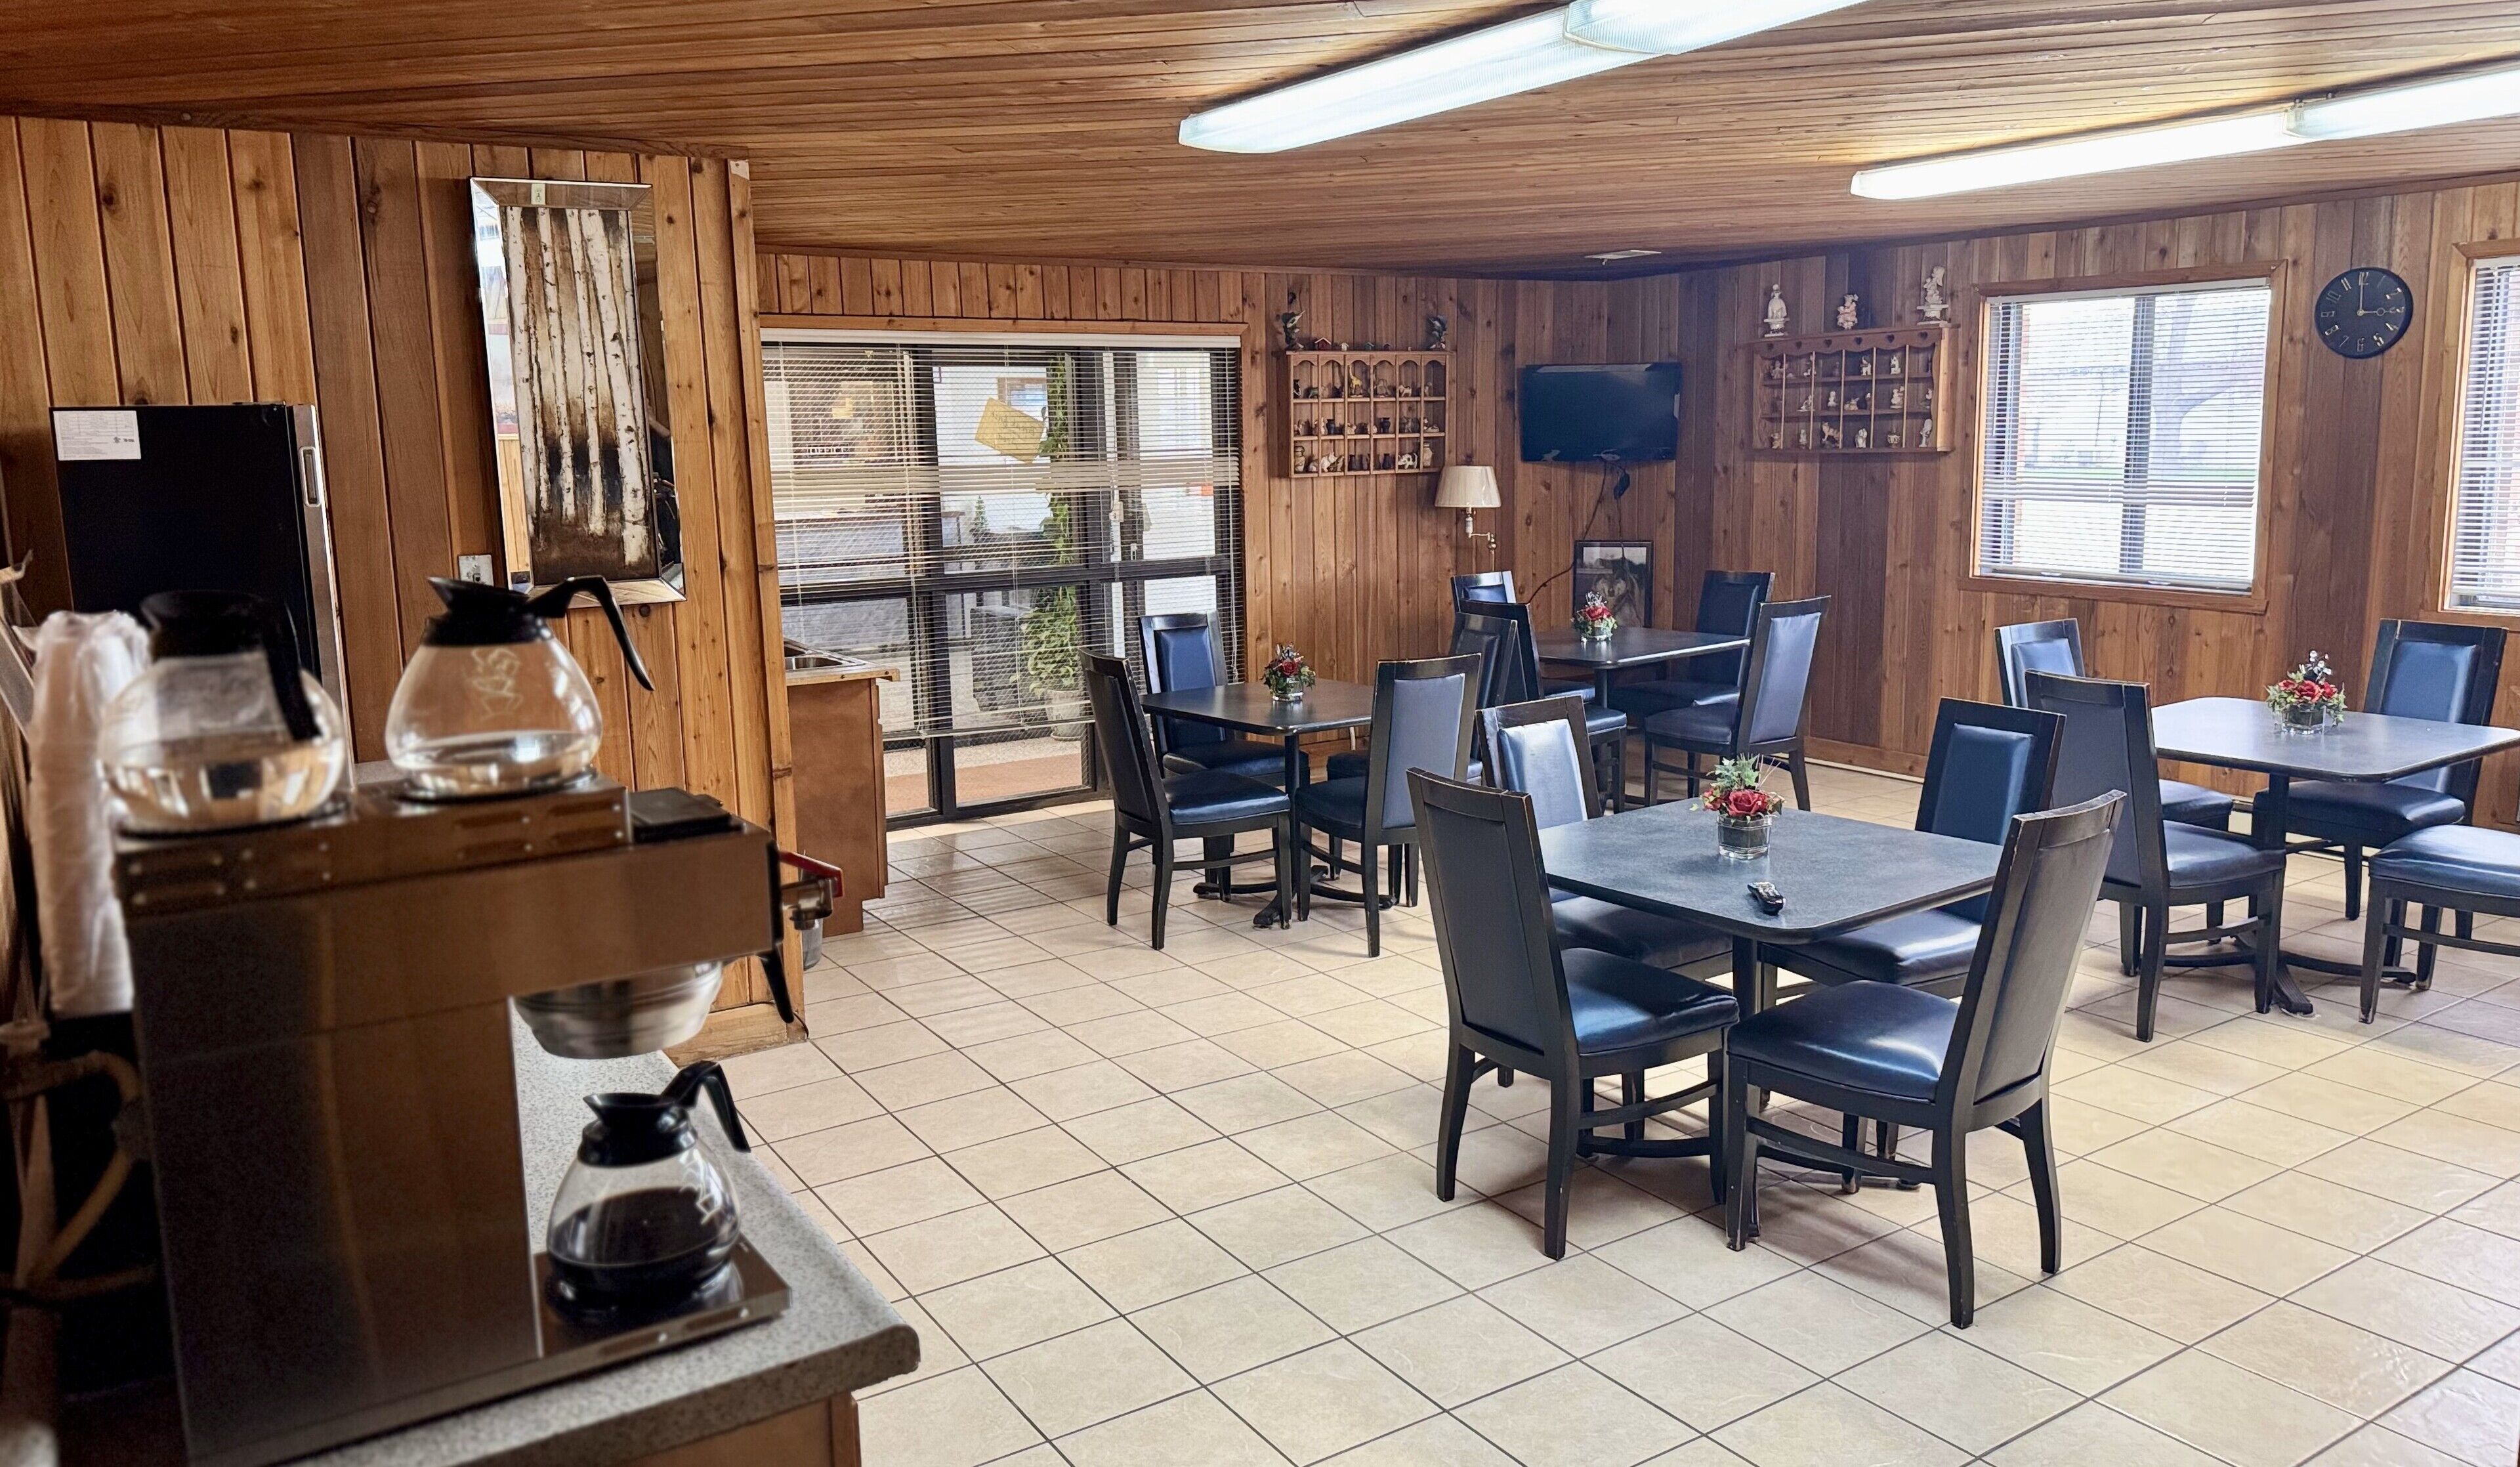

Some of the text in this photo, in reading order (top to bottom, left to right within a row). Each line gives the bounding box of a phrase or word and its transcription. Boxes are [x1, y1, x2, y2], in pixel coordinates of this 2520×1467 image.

[2341, 277, 2352, 291] 11
[2326, 291, 2342, 304] 10
[2385, 287, 2402, 299] 2
[2324, 324, 2340, 335] 8
[2339, 335, 2349, 347] 7
[2357, 338, 2364, 352] 6
[2373, 333, 2384, 347] 5
